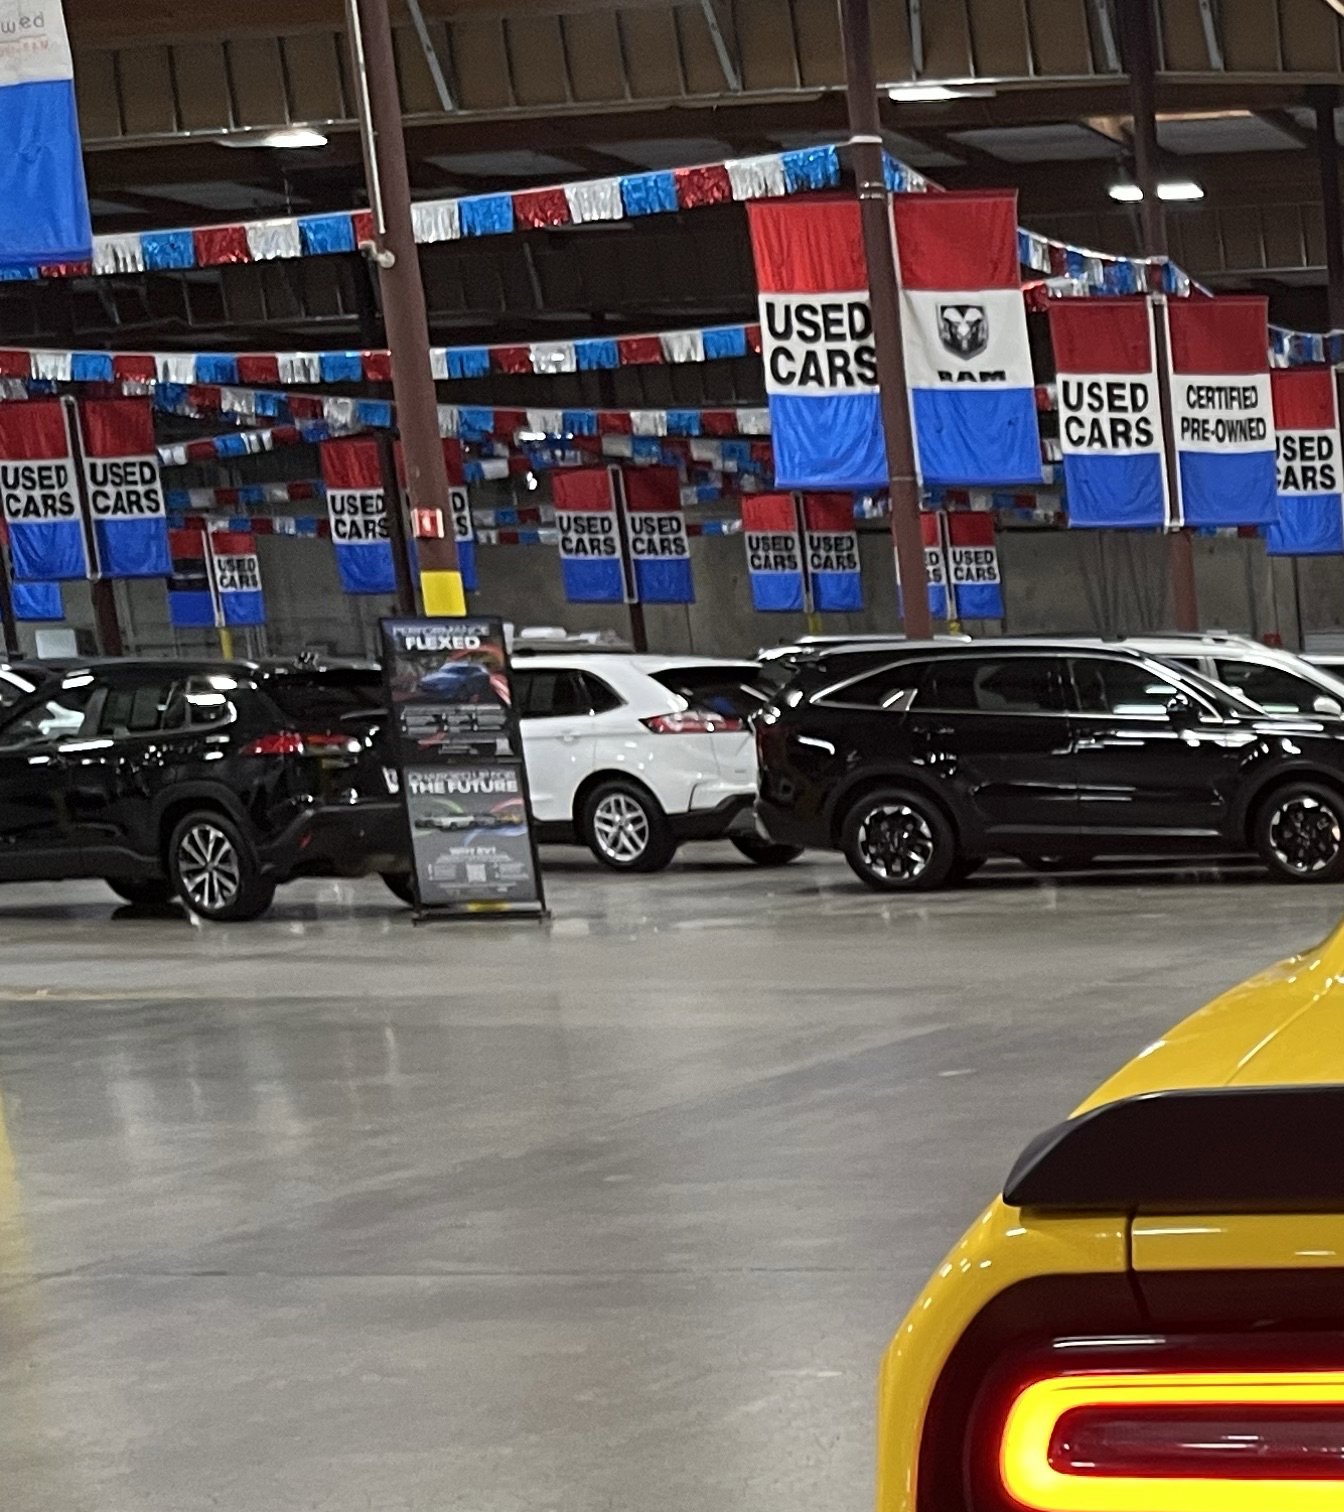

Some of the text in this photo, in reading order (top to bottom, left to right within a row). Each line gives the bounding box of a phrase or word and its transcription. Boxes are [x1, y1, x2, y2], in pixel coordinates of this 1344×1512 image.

[765, 301, 873, 343] USED
[770, 346, 878, 387] CARS
[937, 370, 1006, 382] RAM
[1062, 380, 1149, 413] USED
[1186, 384, 1258, 410] CERTIFIED
[1065, 415, 1154, 448] CARS
[1181, 417, 1267, 443] PRE-OWNED
[1, 465, 68, 490] USED
[89, 461, 157, 487] USED
[1276, 464, 1336, 491] ARS
[5, 492, 75, 518] CARS
[92, 489, 161, 515] CARS
[330, 494, 386, 516] USED
[334, 518, 389, 539] CARS
[559, 515, 613, 535] USED
[631, 516, 681, 536] USED
[561, 536, 616, 555] CARS
[632, 537, 687, 556] CARS
[748, 534, 795, 551] USED
[809, 534, 855, 551] USED
[217, 557, 256, 572] USED
[750, 554, 798, 571] CARS
[811, 553, 857, 570] CARS
[952, 550, 994, 566] USED
[220, 573, 258, 589] CARS
[954, 566, 997, 582] CARS
[405, 635, 481, 650] FLEXED
[410, 778, 518, 795] THE FUTURE
